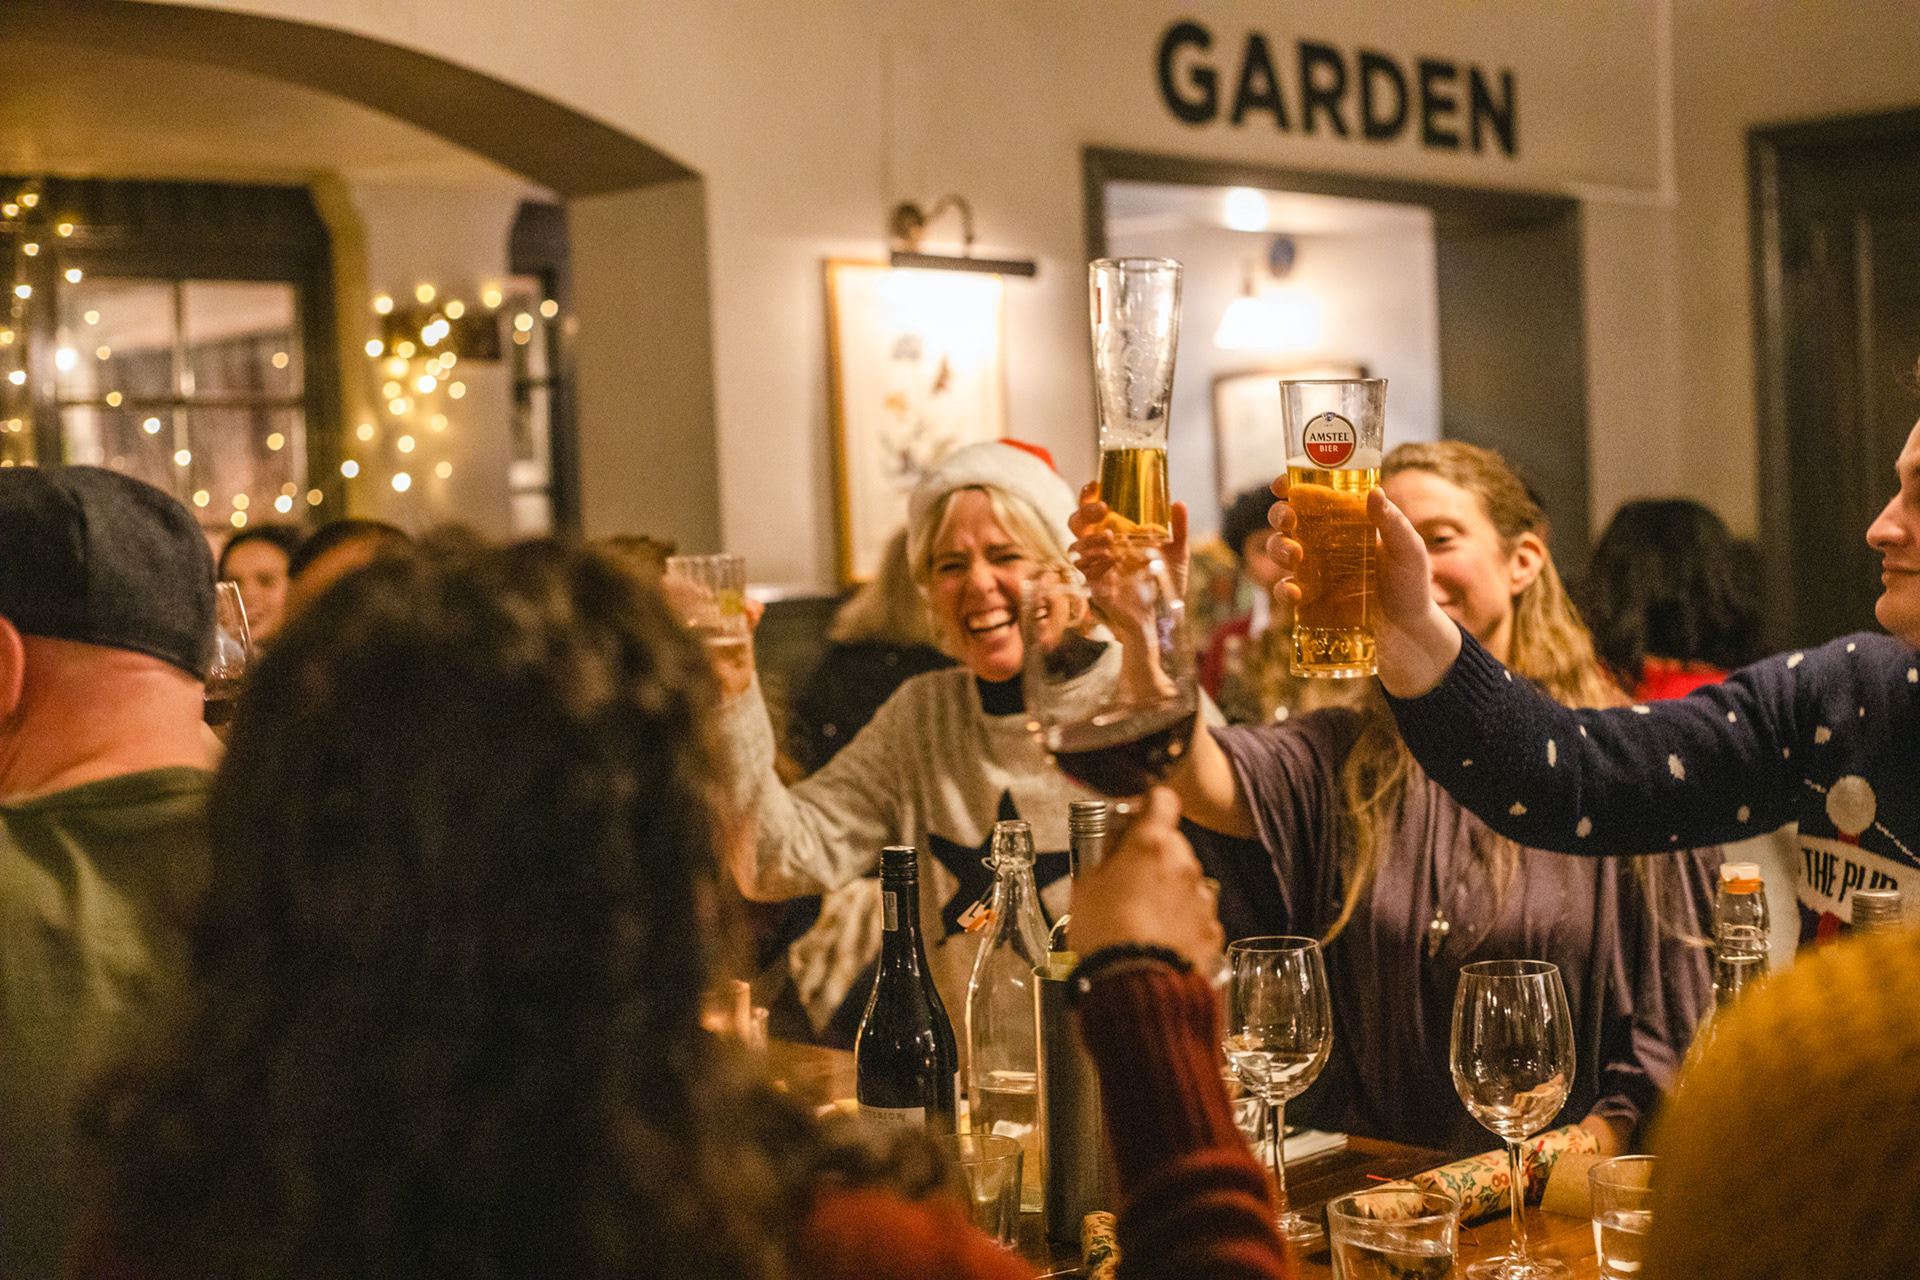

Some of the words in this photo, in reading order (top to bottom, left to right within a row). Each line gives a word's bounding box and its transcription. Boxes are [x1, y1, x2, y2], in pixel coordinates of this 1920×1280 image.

[1156, 19, 1517, 158] GARDEN
[1309, 432, 1349, 441] AMSTEL
[1319, 444, 1338, 452] BIER
[1801, 847, 1839, 897] THE
